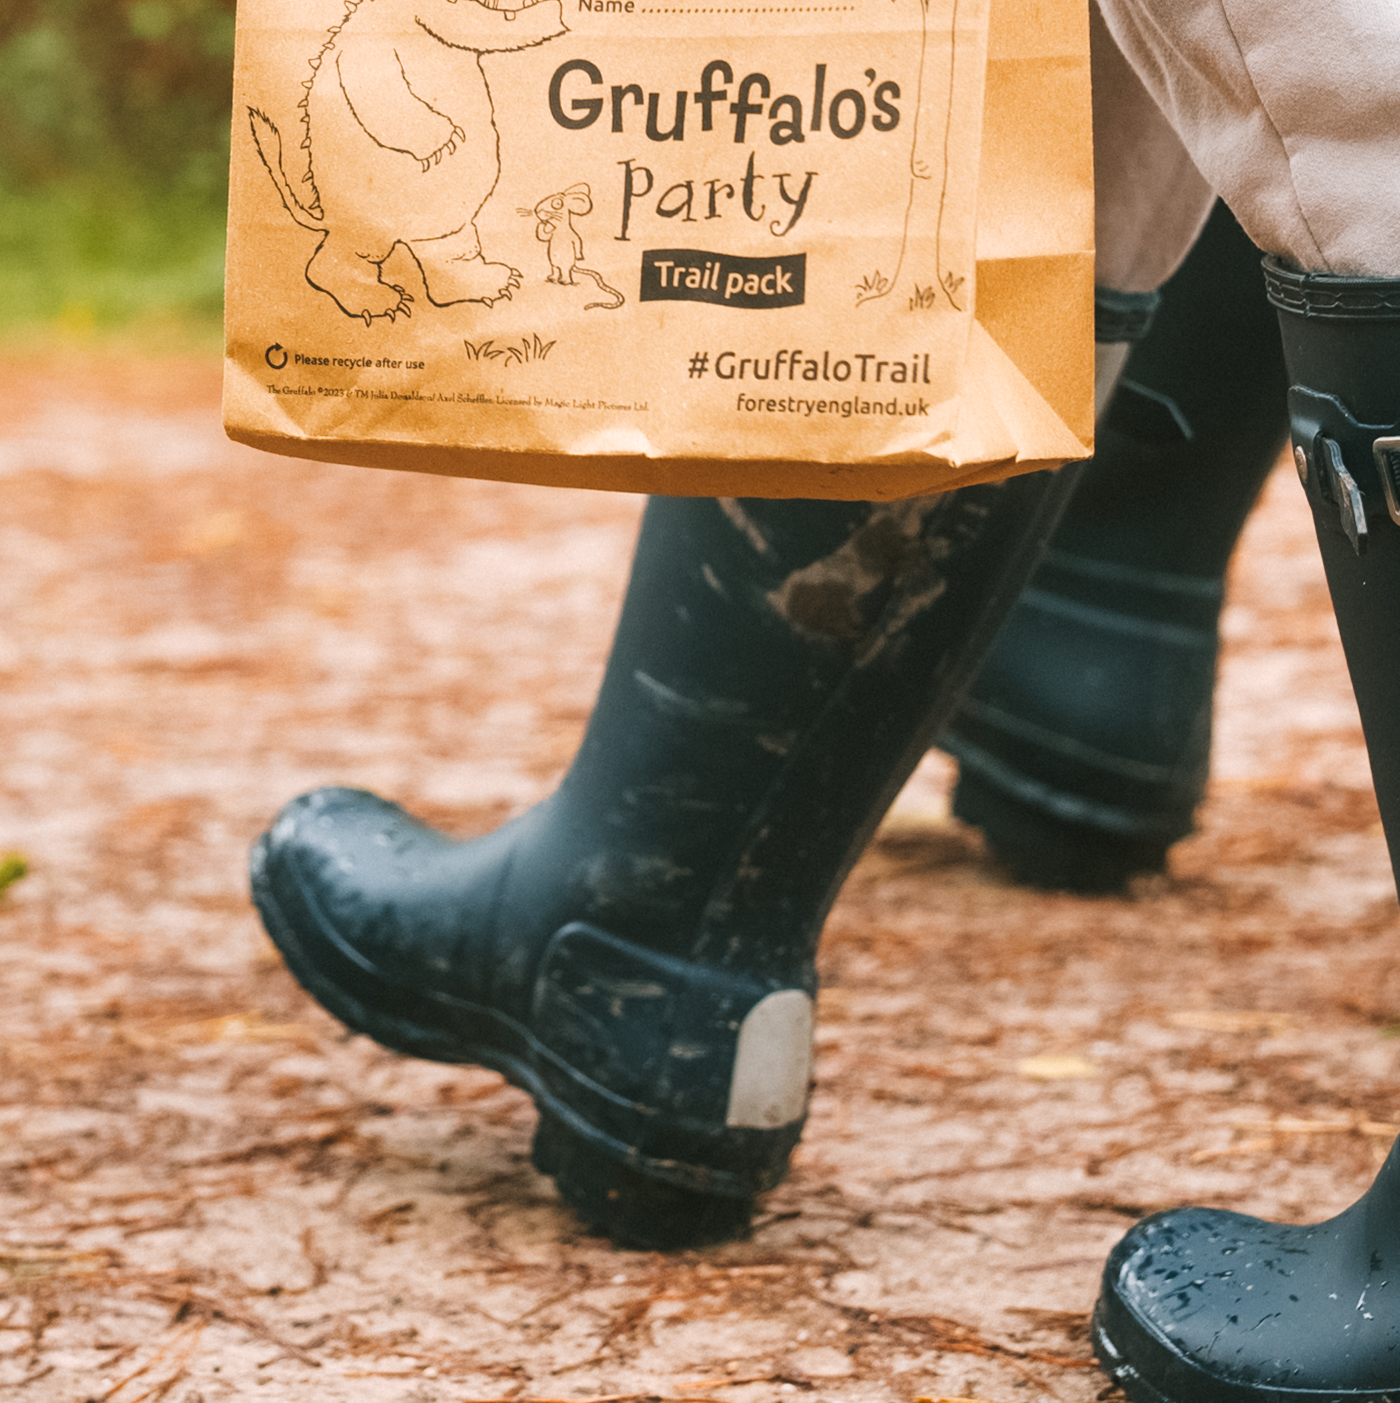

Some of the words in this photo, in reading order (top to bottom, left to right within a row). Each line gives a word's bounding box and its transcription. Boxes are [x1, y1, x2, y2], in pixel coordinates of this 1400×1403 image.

[653, 260, 719, 291] Trail
[725, 265, 793, 300] pack
[294, 354, 330, 366] Please
[332, 356, 372, 370] recycle
[375, 357, 402, 369] after
[405, 361, 425, 369] use
[688, 350, 931, 384] #GruffaloTrail
[267, 384, 281, 395] The
[736, 394, 930, 418] forestryengland.uk
